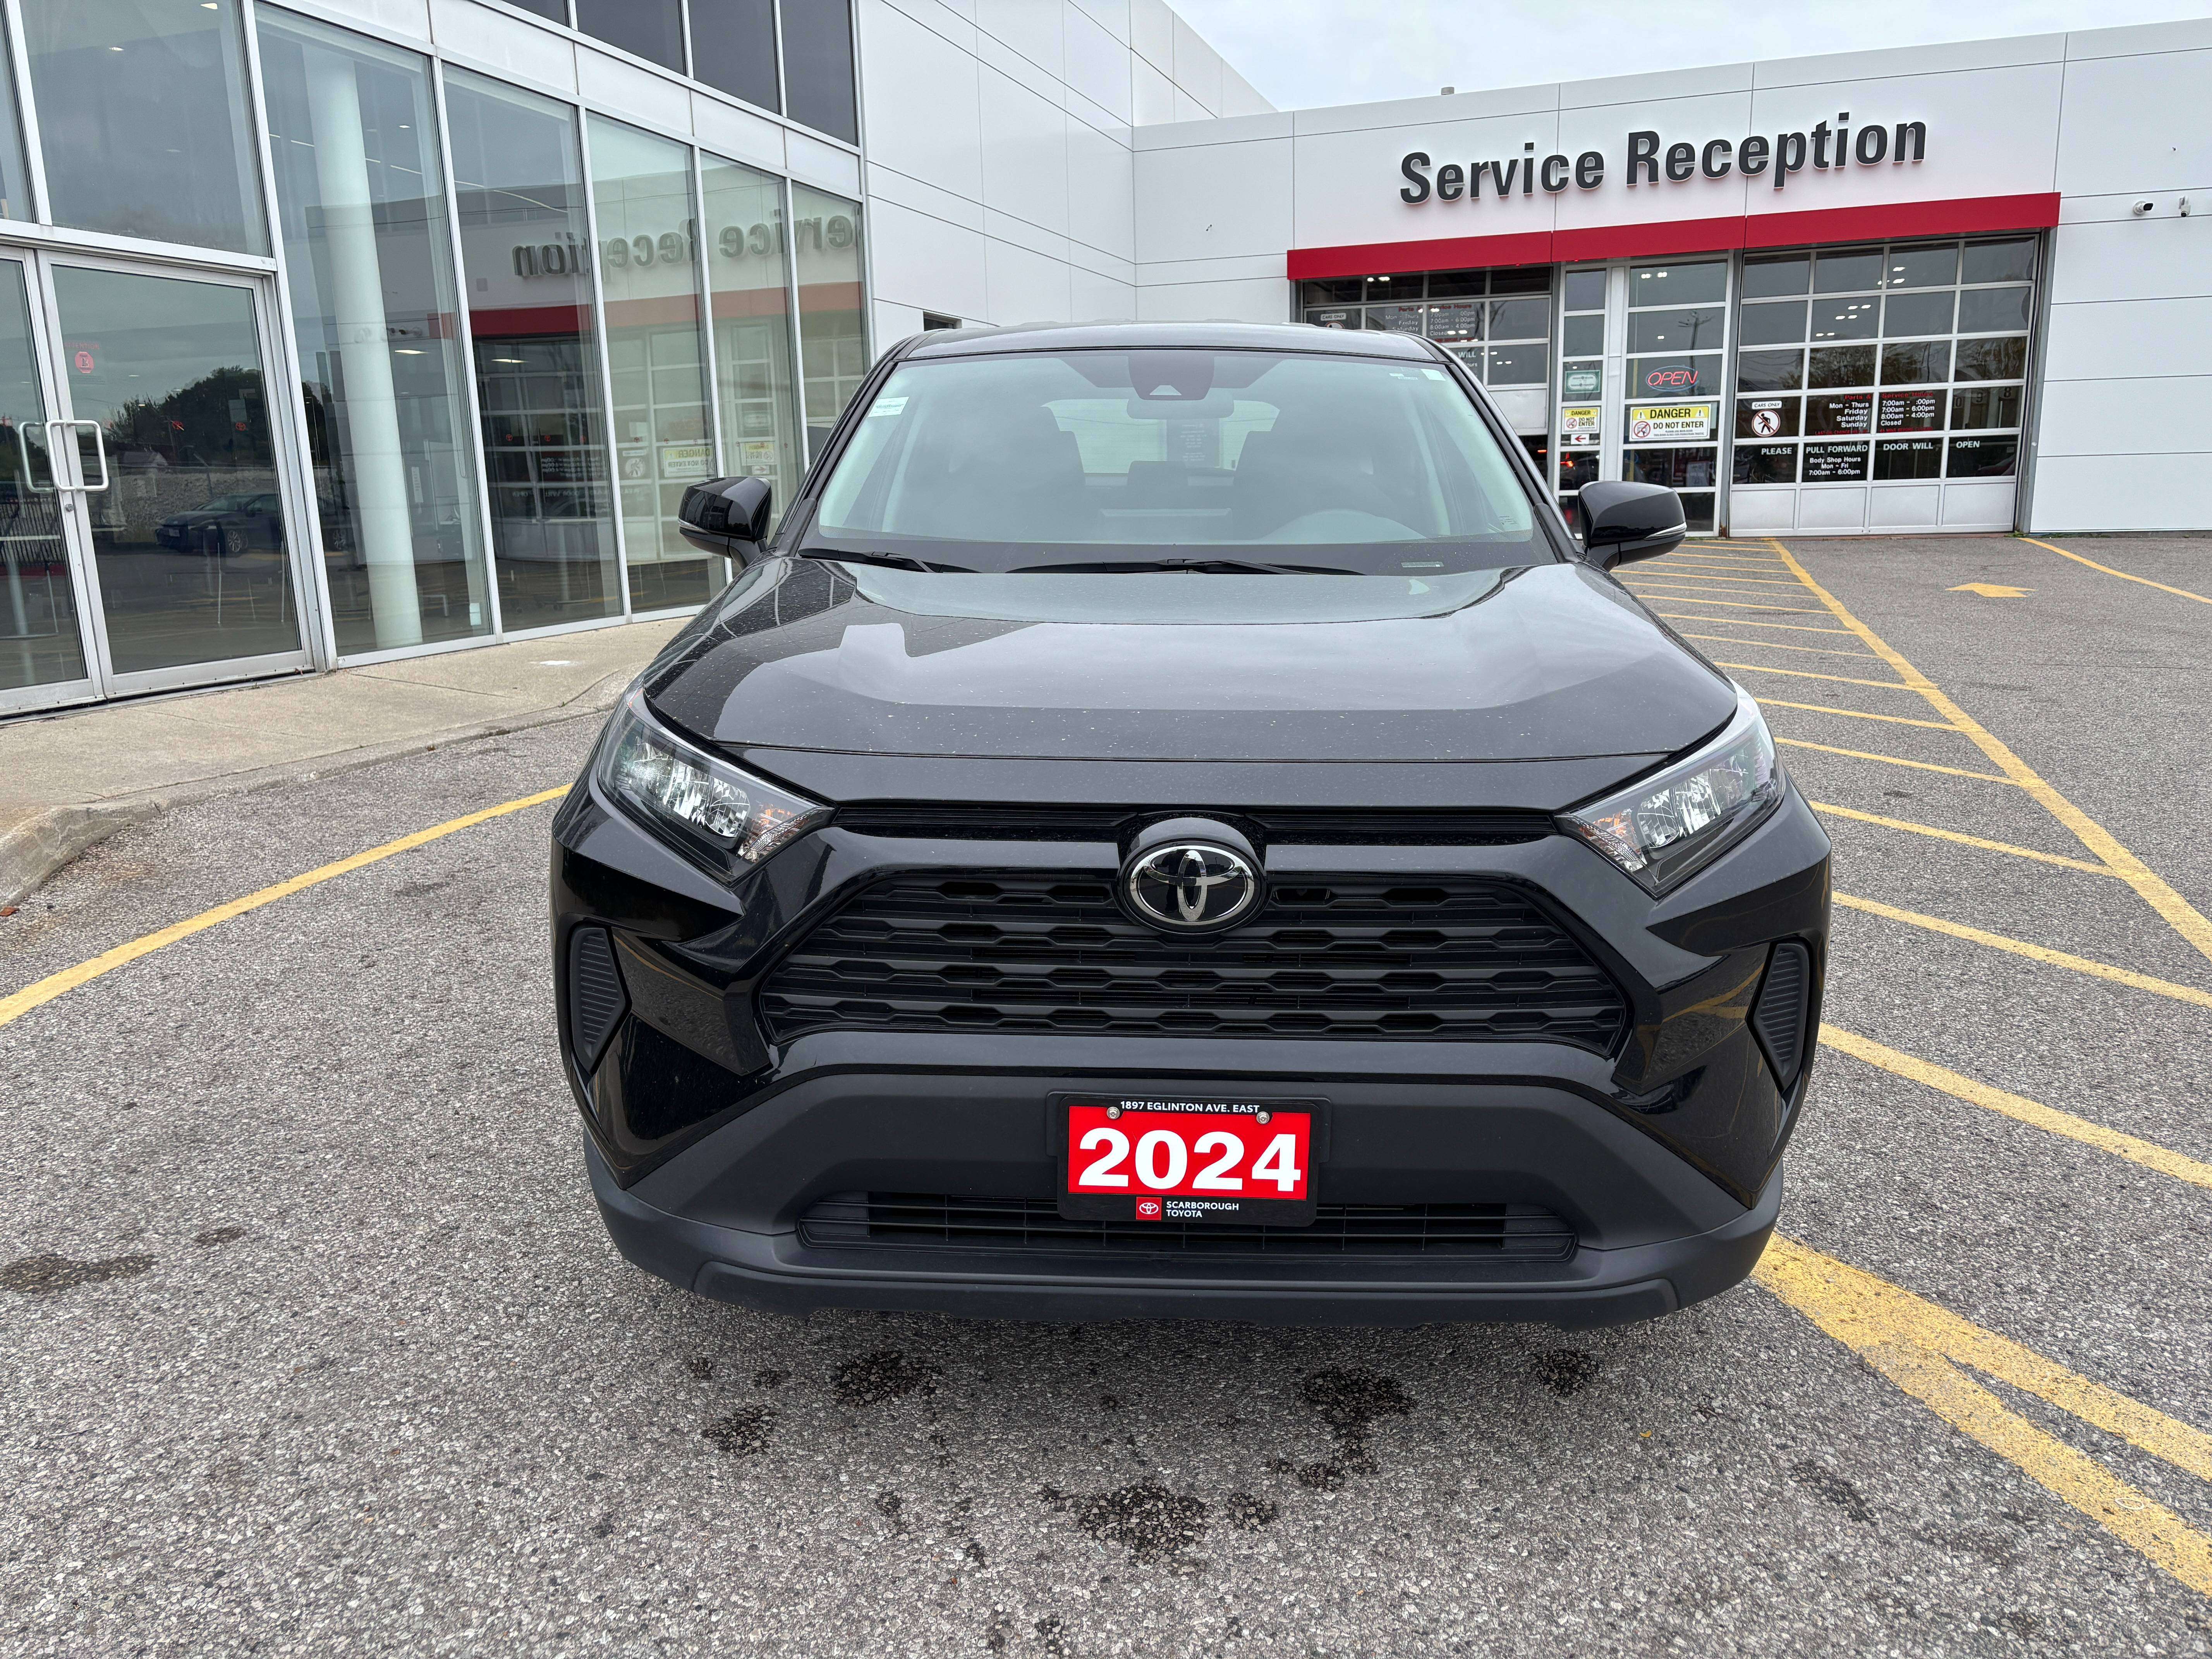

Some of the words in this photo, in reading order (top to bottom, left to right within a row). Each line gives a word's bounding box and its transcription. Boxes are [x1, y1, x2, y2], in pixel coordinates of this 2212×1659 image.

[1400, 142, 1606, 205] Service
[1626, 112, 1927, 190] Reception
[1648, 370, 1698, 386] OPEN
[2004, 387, 2011, 398] 8
[1650, 408, 1691, 419] DANGER
[1761, 447, 1793, 455] PLEASE
[1828, 445, 1868, 453] FORWARD
[1883, 443, 1909, 451] DOOR
[1956, 440, 1980, 448] OPEN
[1121, 1101, 1145, 1110] 1897
[1147, 1102, 1203, 1112] EGLINTON
[1205, 1104, 1230, 1113] AVE.
[1233, 1104, 1260, 1113] EAST
[1078, 1127, 1301, 1192] 2024
[1166, 1201, 1239, 1211] SCARBOROUGH
[1166, 1210, 1202, 1218] TOYOTA
